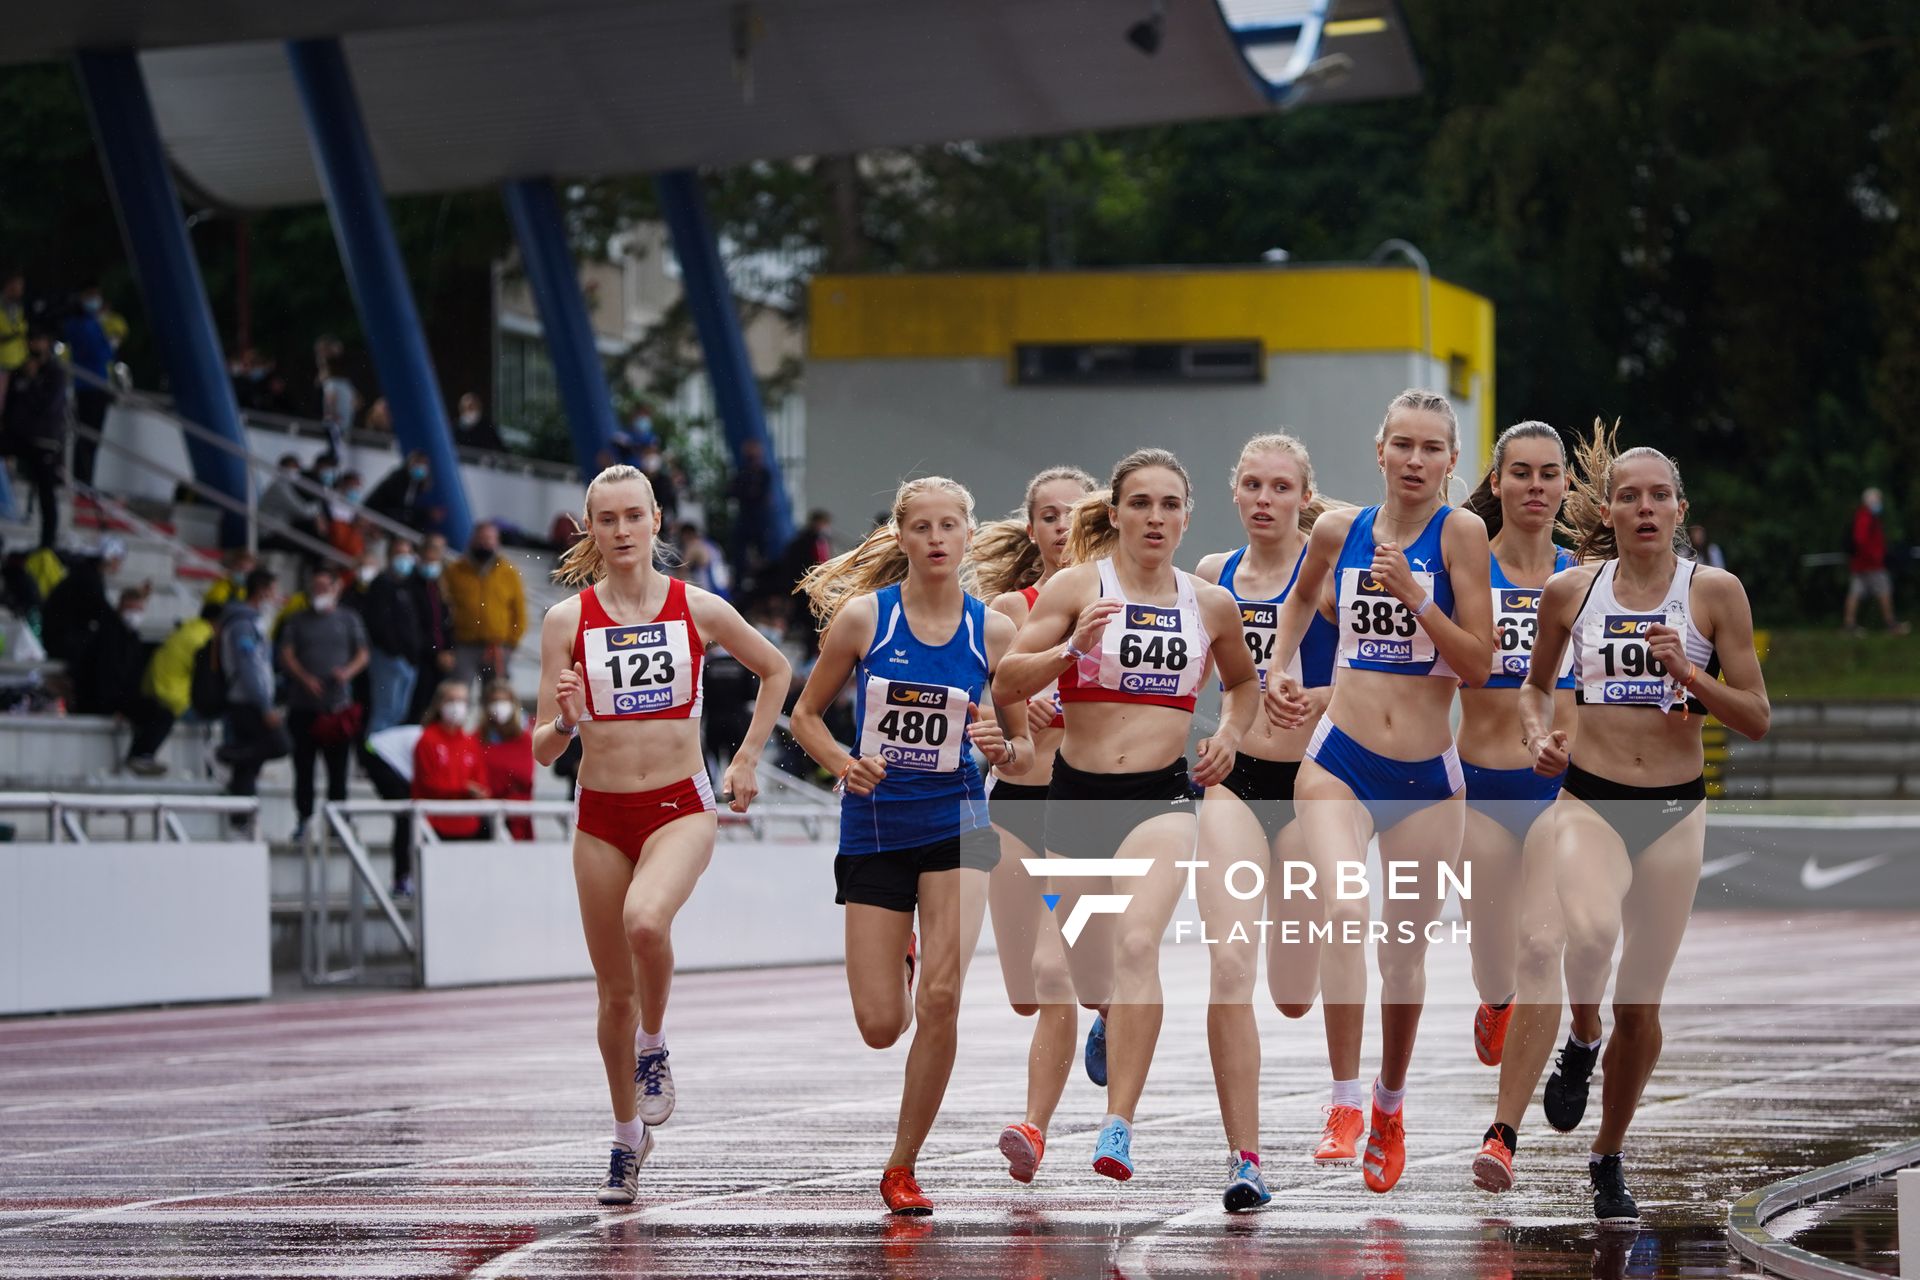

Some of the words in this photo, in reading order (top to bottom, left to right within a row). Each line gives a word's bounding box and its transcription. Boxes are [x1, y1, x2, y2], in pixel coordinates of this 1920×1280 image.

[1155, 614, 1176, 628] GLS
[1255, 610, 1273, 624] GLS
[1351, 600, 1417, 638] 383
[638, 630, 662, 644] GLS
[1120, 634, 1188, 671] 648
[1380, 644, 1410, 654] PLAN
[889, 656, 909, 664] erima
[1598, 643, 1668, 678] 196
[605, 650, 676, 688] 123
[1145, 677, 1177, 687] PLAN
[1628, 685, 1662, 695] PLAN
[638, 691, 670, 704] PLAN
[918, 692, 943, 705] GLS
[878, 710, 948, 746] 480
[904, 751, 937, 762] PLAN
[1662, 806, 1682, 814] erima
